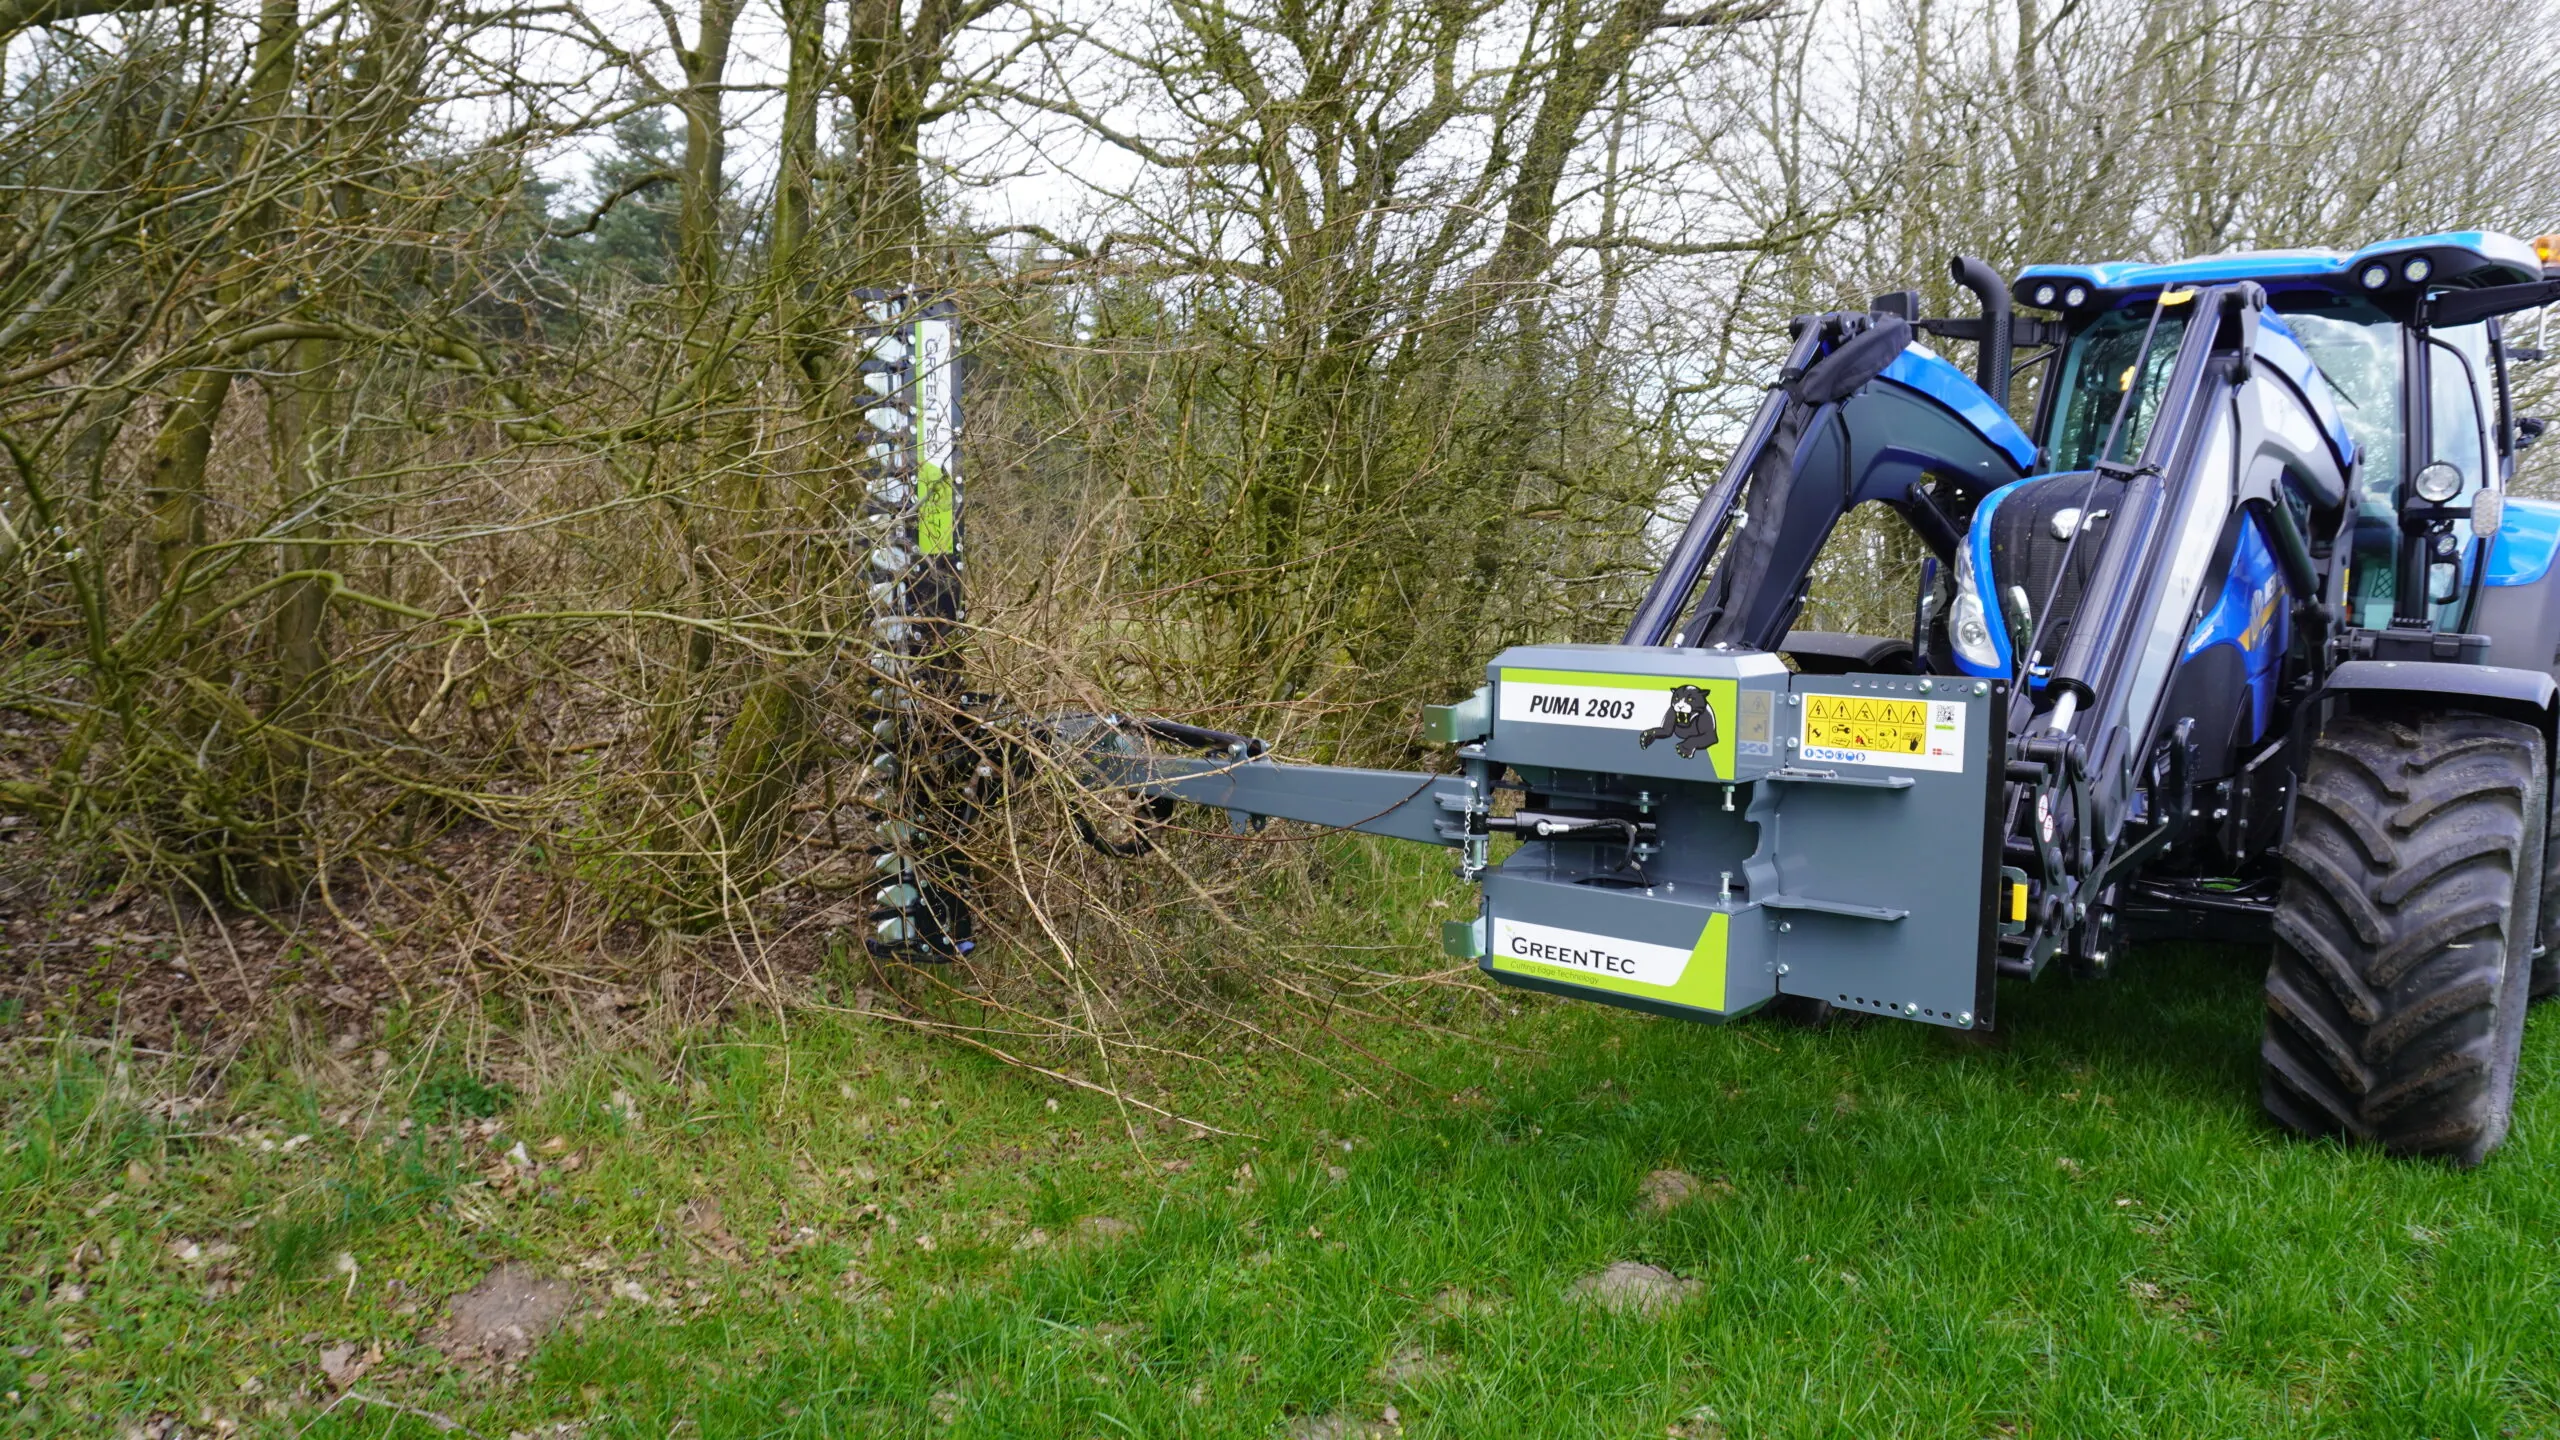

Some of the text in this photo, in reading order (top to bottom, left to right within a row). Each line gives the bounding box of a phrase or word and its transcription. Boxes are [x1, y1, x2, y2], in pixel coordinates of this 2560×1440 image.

[1529, 695, 1635, 720] PUMA 2803
[1510, 960, 1600, 985] Cutting Edge Technology
